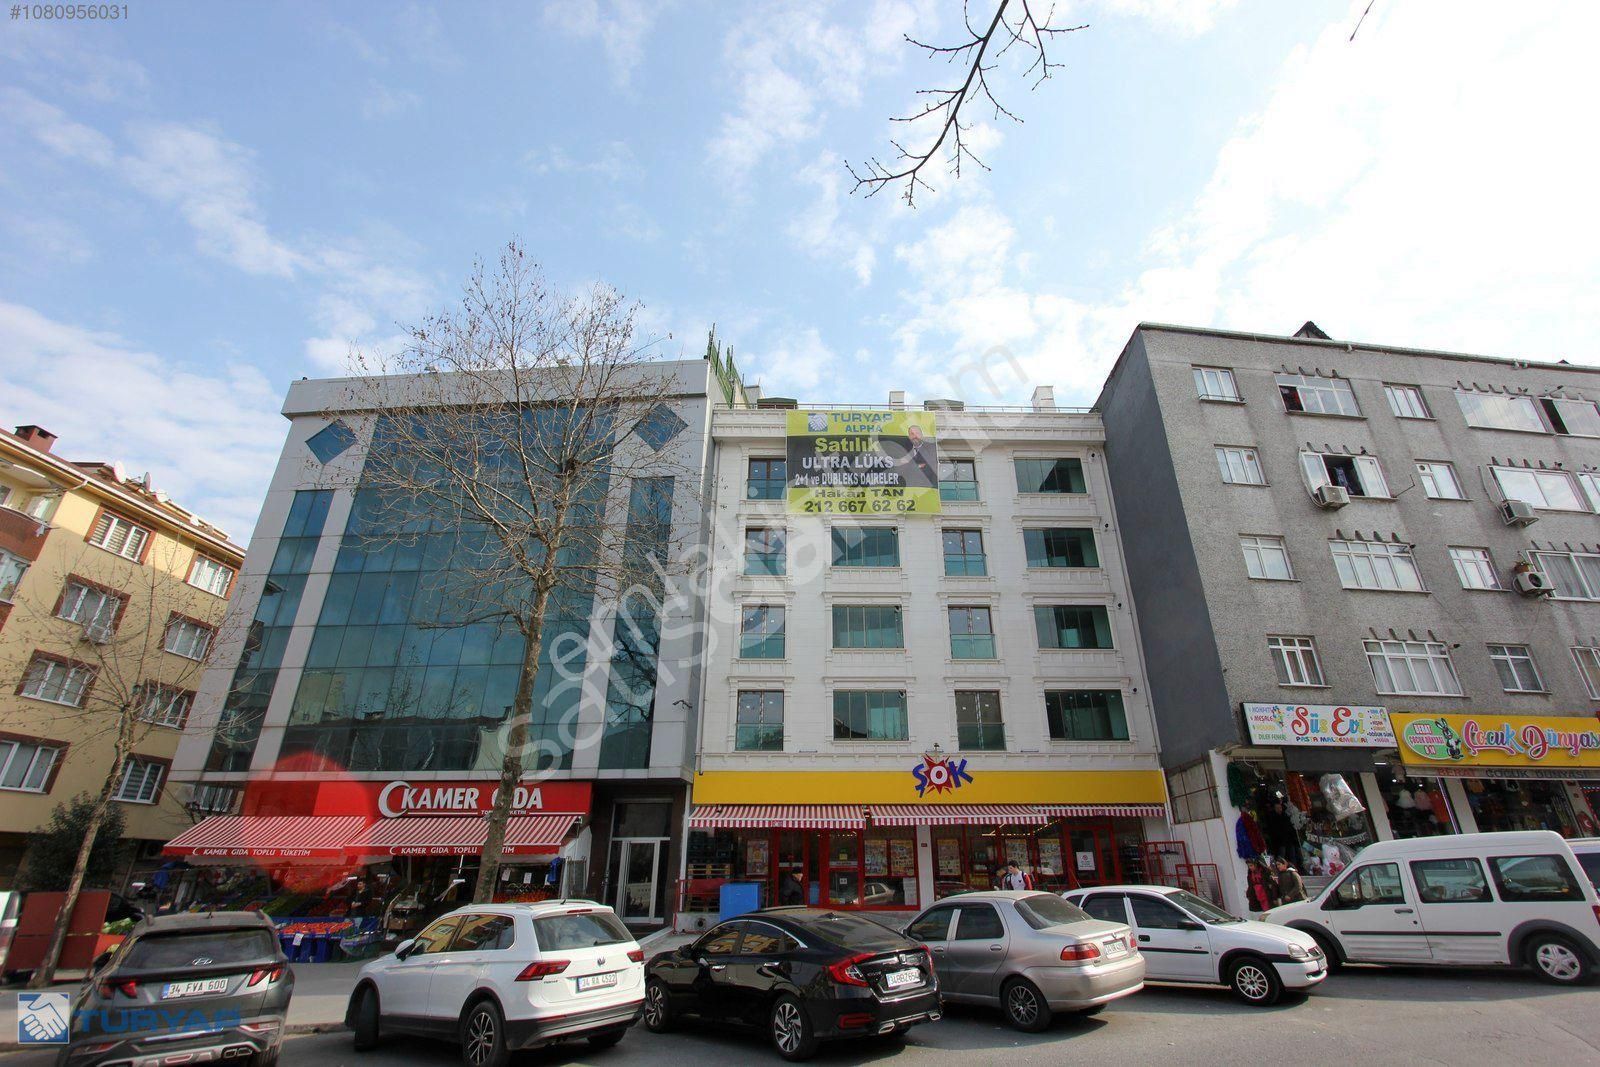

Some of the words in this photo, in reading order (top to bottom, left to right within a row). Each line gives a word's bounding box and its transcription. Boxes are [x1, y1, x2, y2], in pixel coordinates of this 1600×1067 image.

[845, 425, 883, 433] ALPHA
[815, 437, 880, 452] Satılık
[802, 456, 850, 469] ULTRA
[855, 454, 894, 469] LÜKS
[811, 476, 819, 485] ve
[821, 473, 859, 485] DUBLEKS
[860, 470, 899, 485] DAİRELER
[815, 489, 865, 498] Hakan
[871, 488, 904, 497] TAN
[804, 501, 833, 512] 212
[838, 501, 866, 512] 667
[872, 500, 891, 512] 62
[896, 500, 916, 511] 62
[1291, 706, 1328, 736] Süs
[1463, 720, 1523, 756] Çocuk
[912, 758, 974, 798] ŞOK
[400, 787, 480, 809] KAMER
[491, 787, 543, 809] DA
[203, 848, 227, 856] KAMER
[231, 848, 249, 856] GIDA
[252, 848, 275, 856] TOPLU
[280, 848, 311, 856] TÜKETİM
[401, 847, 427, 855] KAMER
[430, 846, 449, 854] GIDA
[453, 846, 478, 854] TOPLU
[170, 984, 181, 994] 34
[186, 982, 203, 992] FVA
[208, 980, 226, 990] 600
